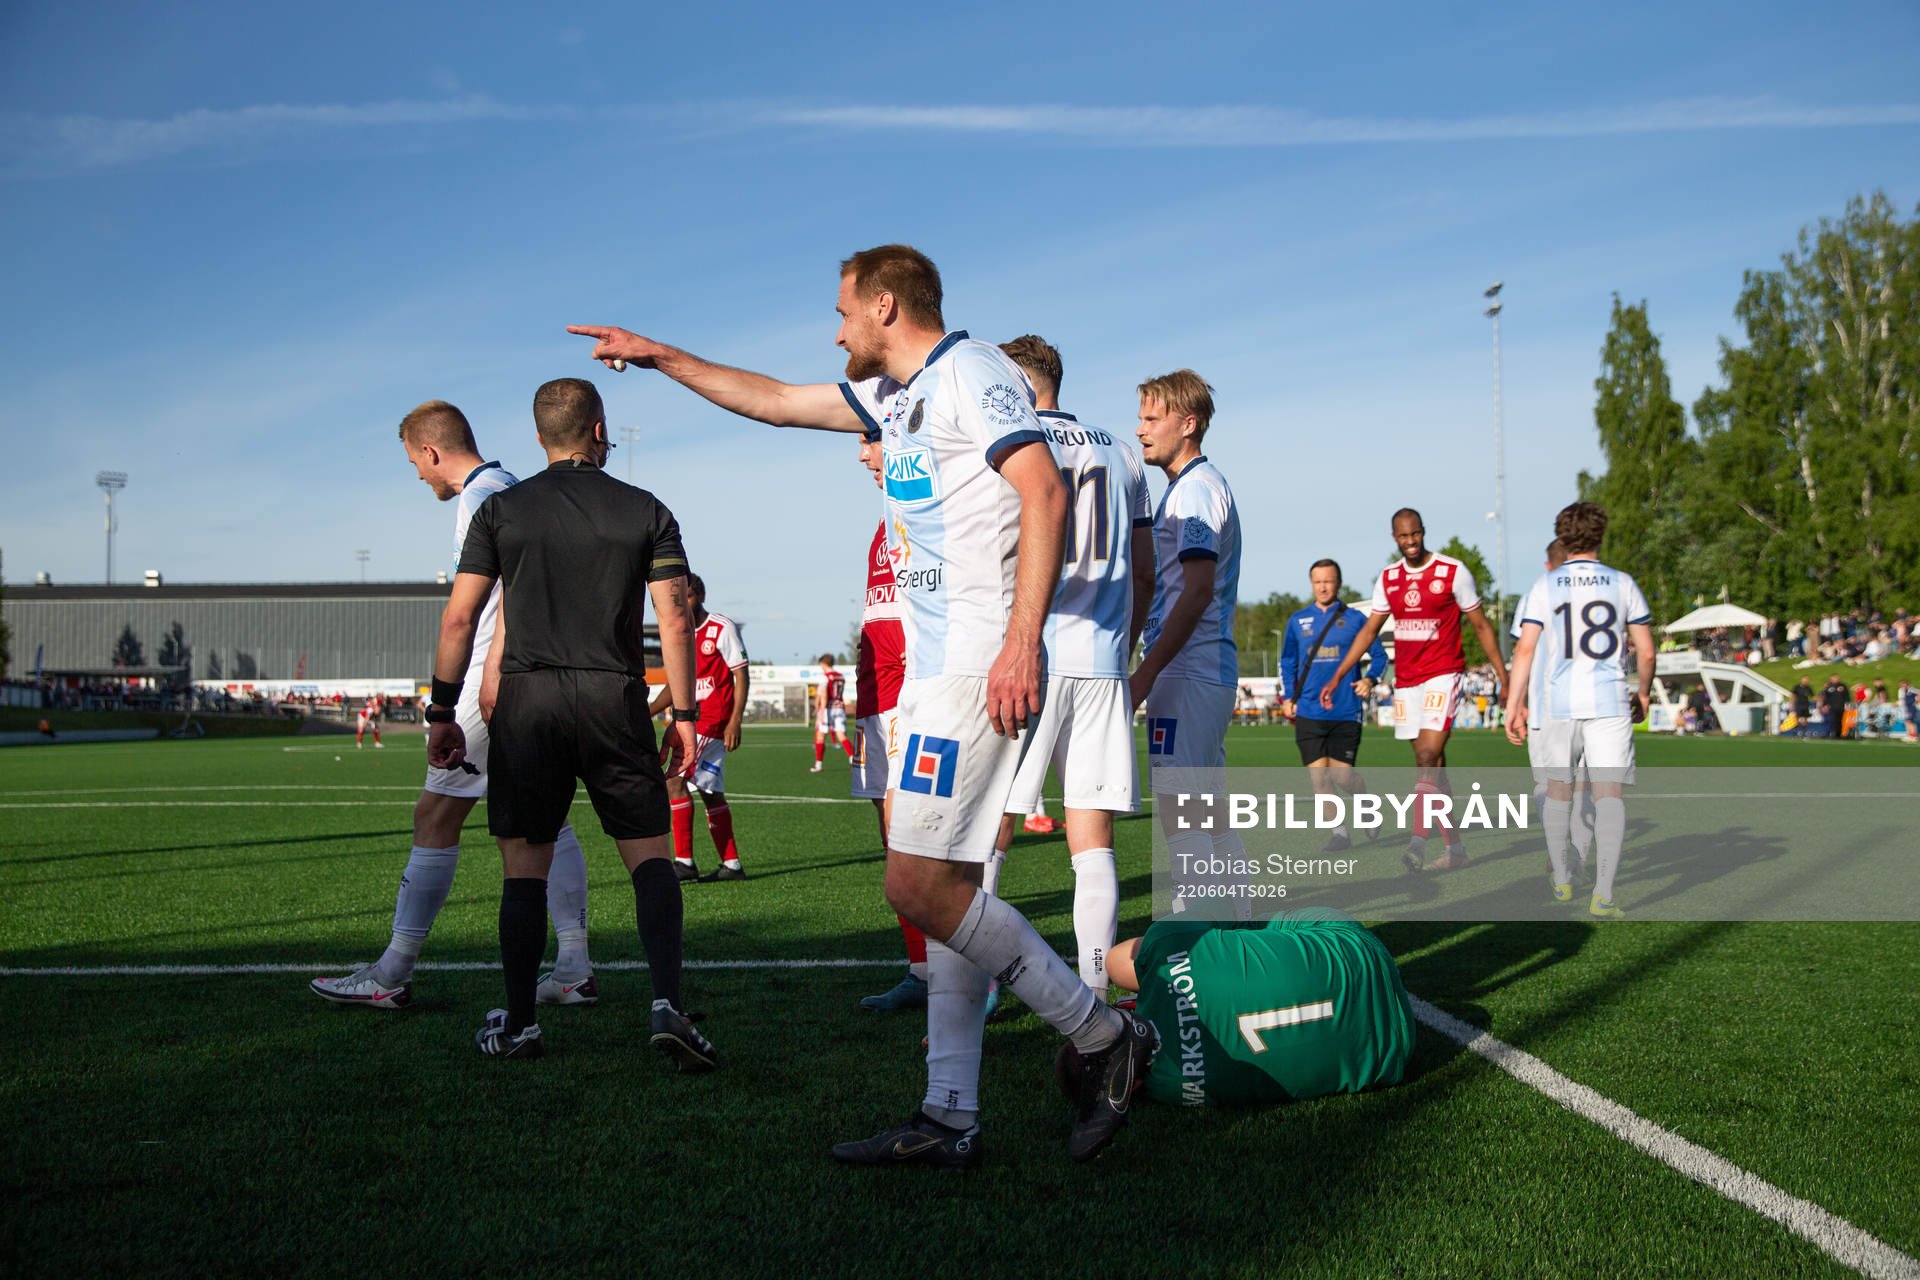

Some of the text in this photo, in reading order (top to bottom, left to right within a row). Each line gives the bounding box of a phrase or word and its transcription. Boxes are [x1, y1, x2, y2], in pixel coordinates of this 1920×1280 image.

[1044, 427, 1112, 446] NGLUND
[1060, 465, 1109, 564] 11
[1557, 575, 1610, 587] FRIMAN
[1395, 619, 1440, 632] SANDVIK
[1553, 600, 1619, 660] 18
[1237, 999, 1335, 1054] 1
